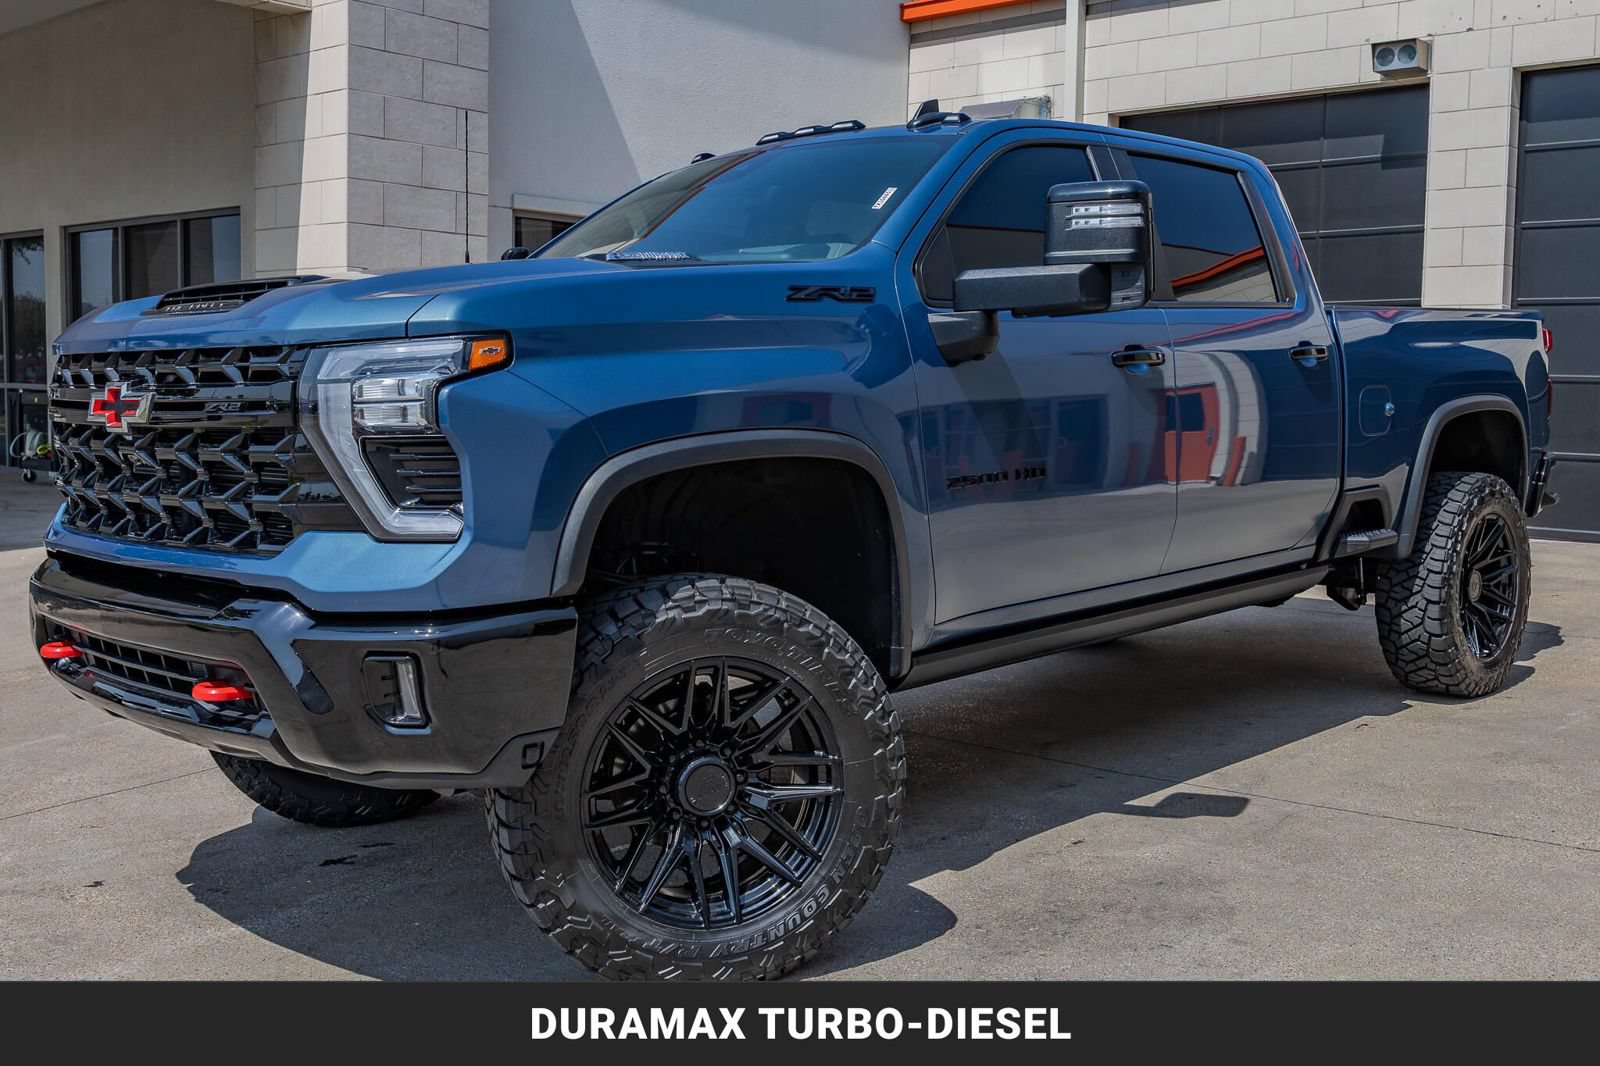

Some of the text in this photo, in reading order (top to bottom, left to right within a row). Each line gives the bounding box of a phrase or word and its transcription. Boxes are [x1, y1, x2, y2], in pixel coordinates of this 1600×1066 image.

[784, 284, 876, 304] ZR2
[204, 401, 243, 413] ZR2
[946, 466, 1048, 490] 2500 HD
[709, 884, 831, 959] COUNTRY
